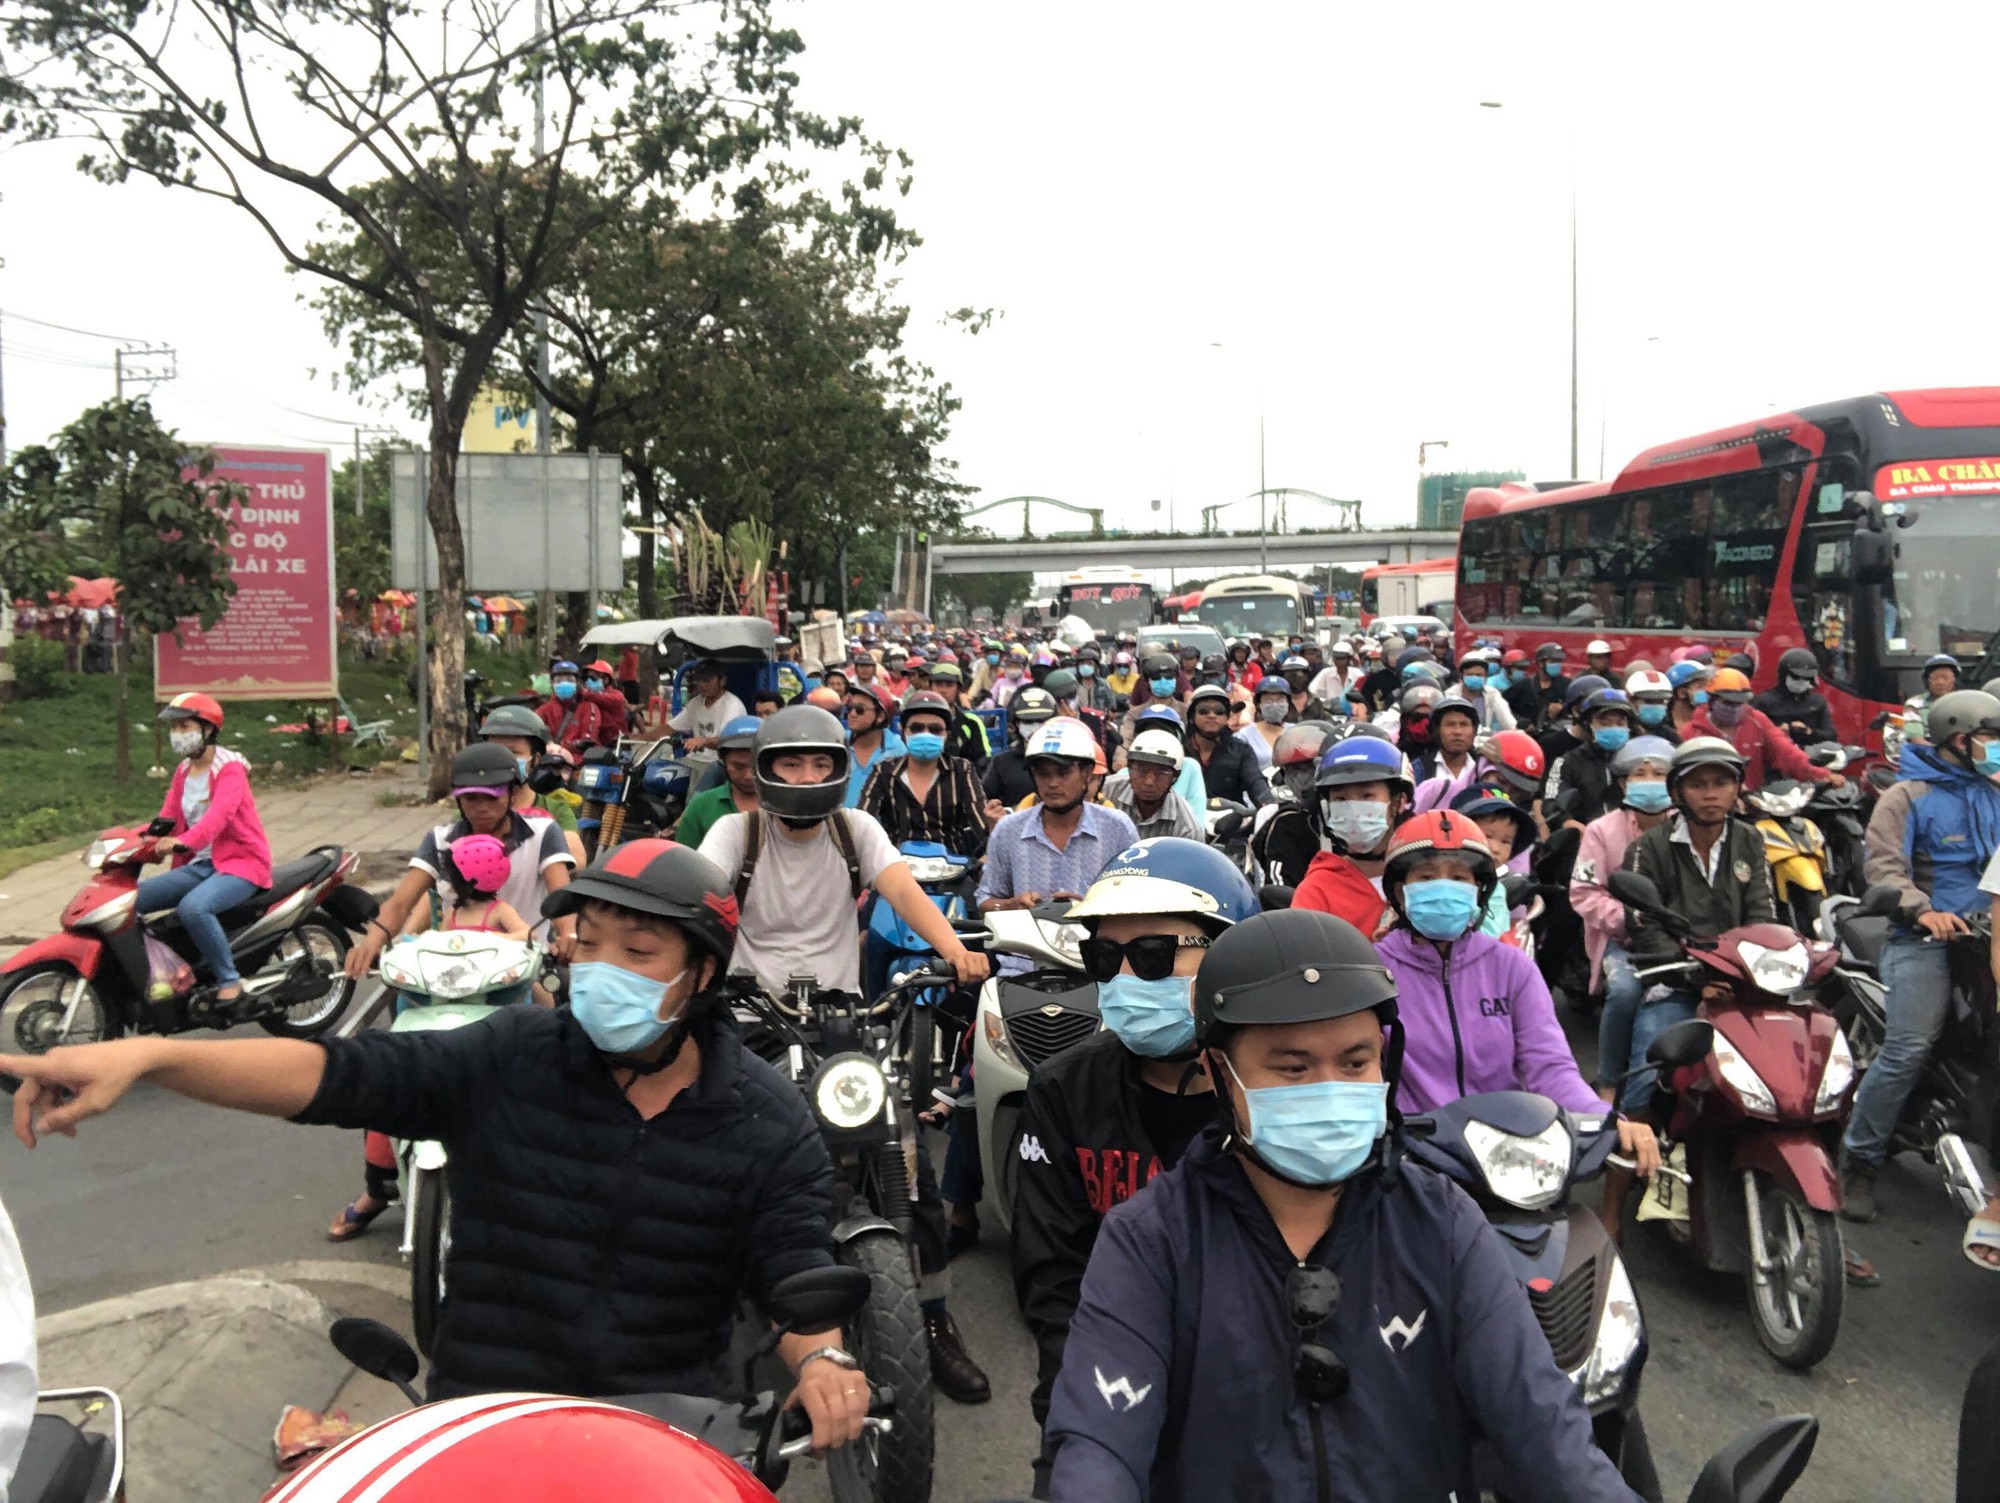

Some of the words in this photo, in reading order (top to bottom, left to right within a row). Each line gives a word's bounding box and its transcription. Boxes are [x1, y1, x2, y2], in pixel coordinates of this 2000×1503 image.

[1891, 466, 1932, 485] BA
[256, 479, 305, 500] THỦ
[275, 558, 306, 573] XE
